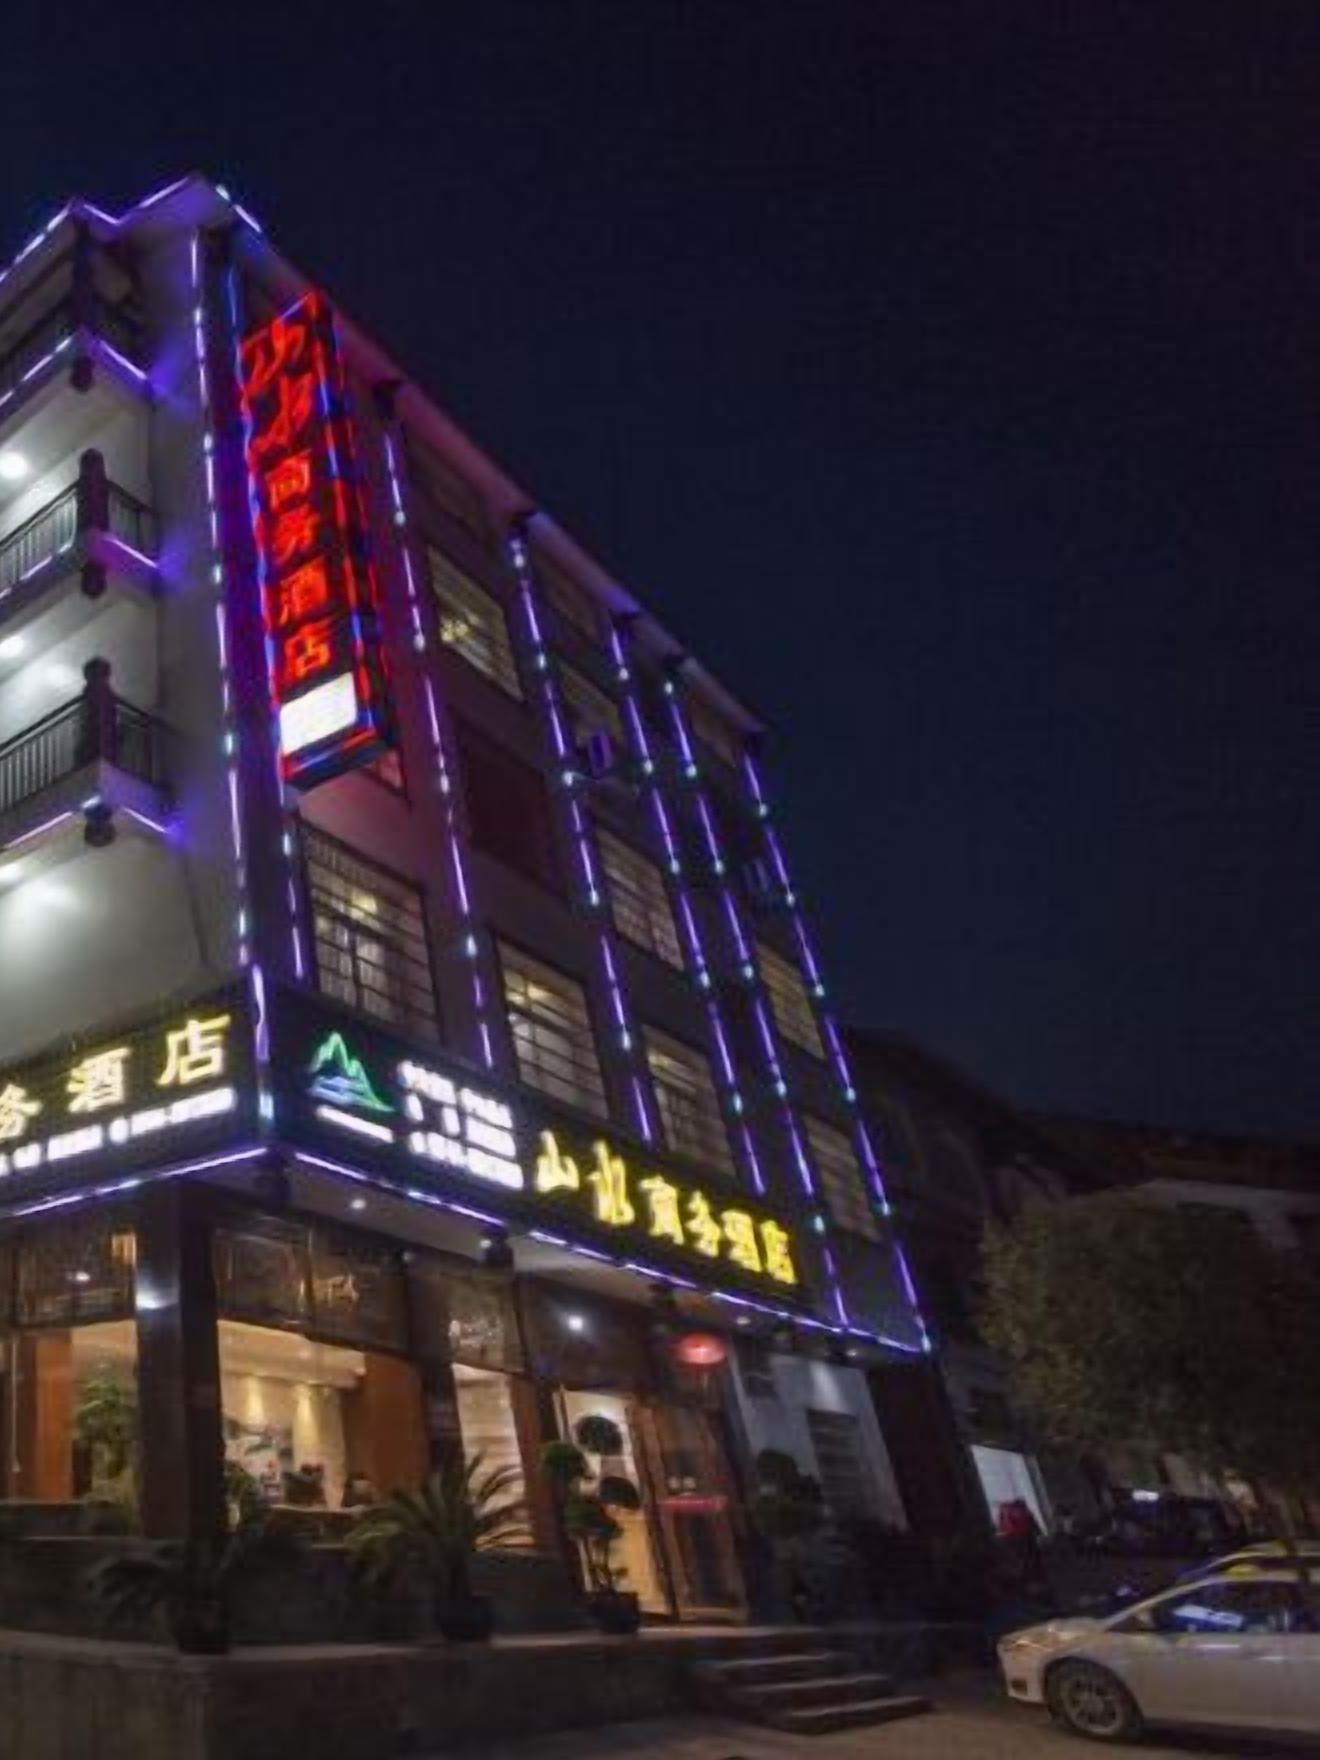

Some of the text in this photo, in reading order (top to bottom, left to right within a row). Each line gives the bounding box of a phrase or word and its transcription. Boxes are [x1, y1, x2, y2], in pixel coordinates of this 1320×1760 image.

[534, 1129, 797, 1285] 山水商务酒店
